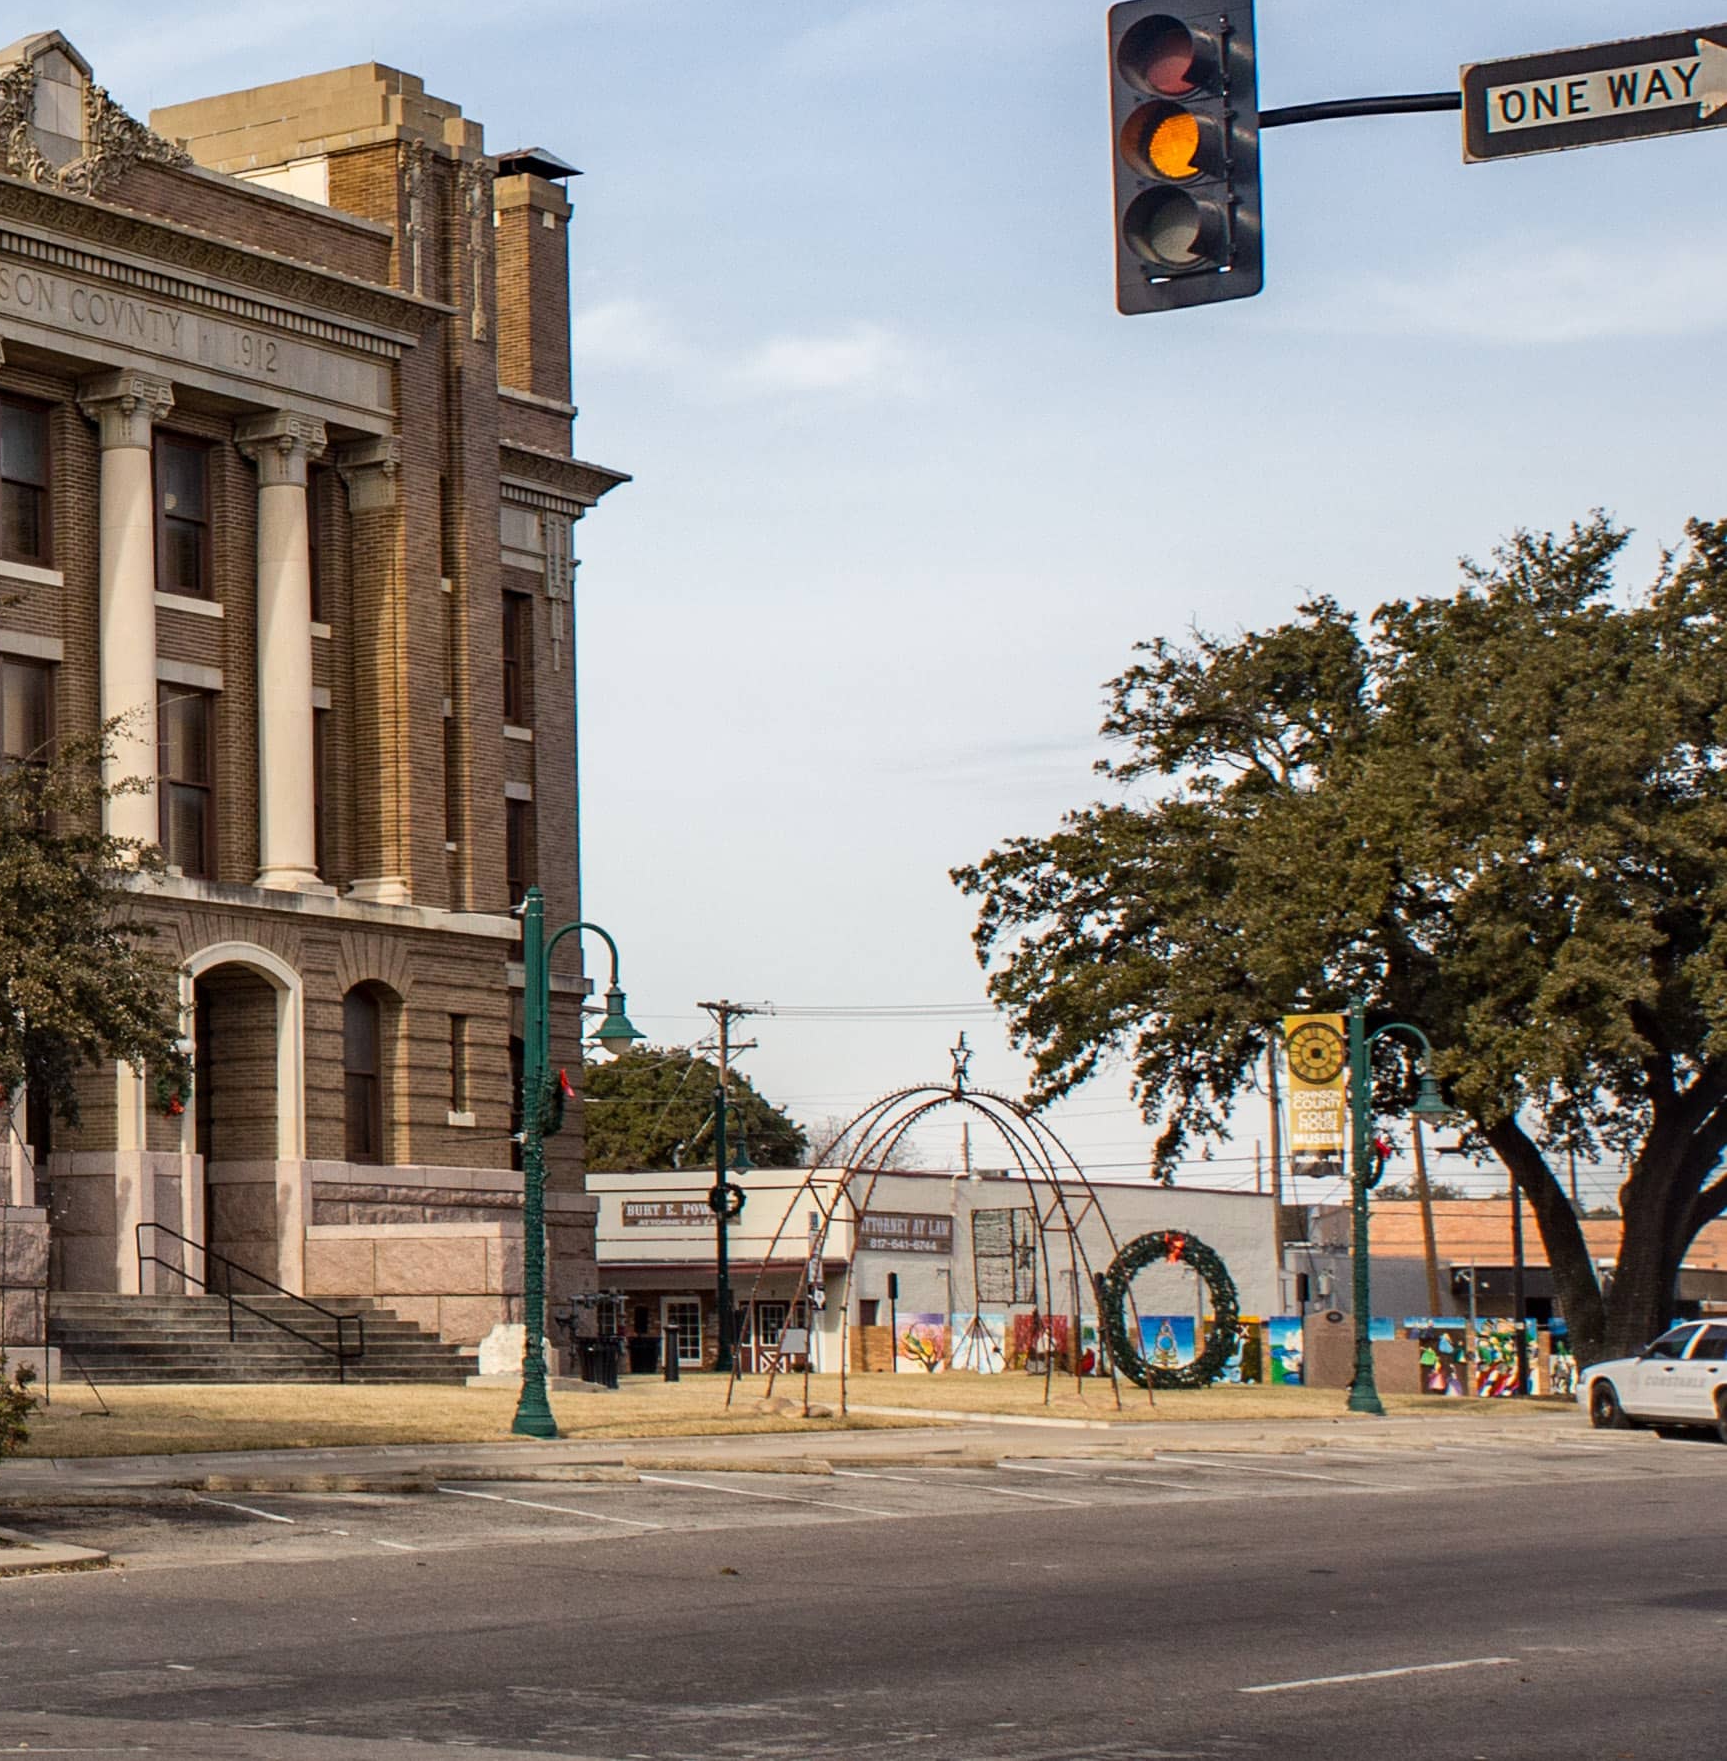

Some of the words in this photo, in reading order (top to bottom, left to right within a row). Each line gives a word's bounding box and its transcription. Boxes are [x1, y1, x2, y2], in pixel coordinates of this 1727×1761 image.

[1499, 79, 1590, 124] ONE
[1606, 62, 1702, 109] WAY
[70, 288, 182, 348] COVNTY
[232, 332, 278, 374] 1912
[1293, 1099, 1341, 1110] COUNTY
[1299, 1111, 1338, 1121] COURT
[1299, 1120, 1339, 1131] HOUSE
[1292, 1133, 1343, 1144] MUSEUM
[627, 1204, 661, 1216] BURT
[912, 1219, 927, 1235] AT
[929, 1220, 950, 1236] LAW
